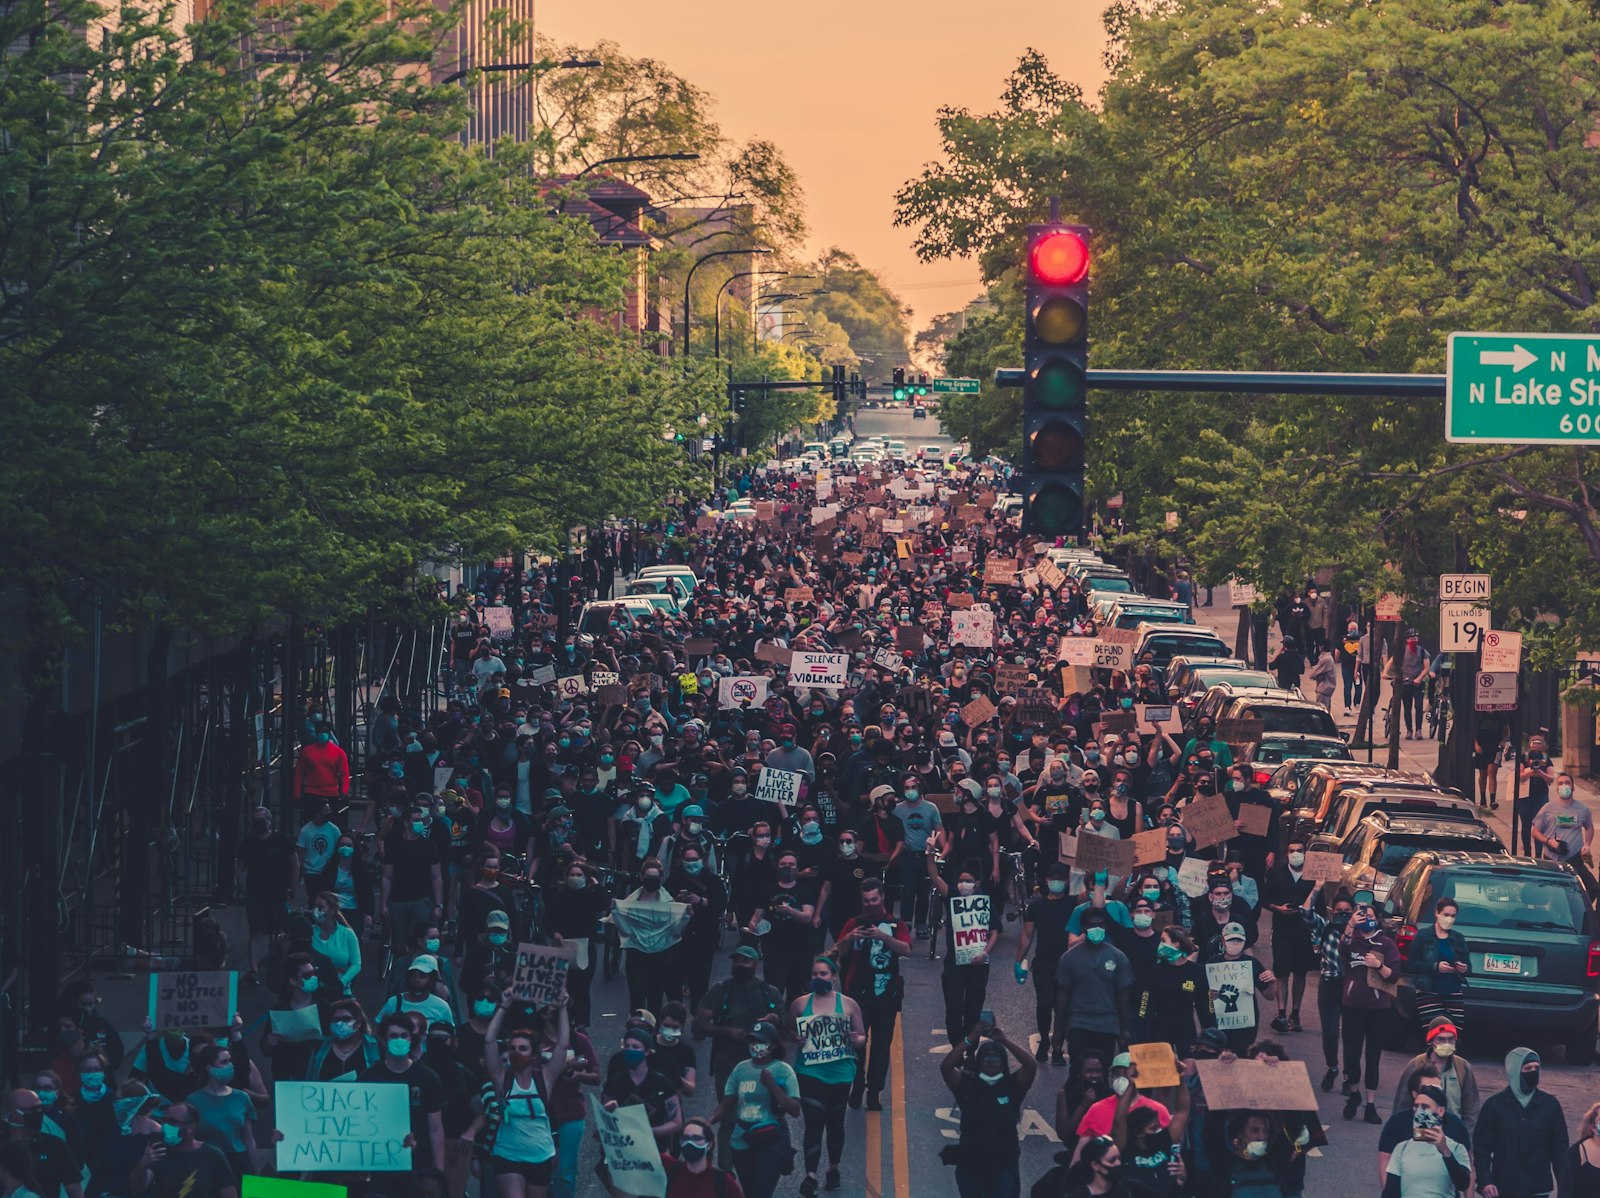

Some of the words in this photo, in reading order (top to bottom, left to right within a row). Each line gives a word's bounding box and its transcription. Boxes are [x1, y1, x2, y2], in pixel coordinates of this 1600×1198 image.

[1551, 351, 1565, 372] N
[1470, 383, 1485, 404] N
[1495, 376, 1562, 405] Lake
[1039, 560, 1064, 587] BLM
[1445, 580, 1486, 594] BEGIN
[1453, 622, 1478, 643] 19
[1095, 645, 1124, 656] DEFUND
[804, 655, 843, 665] SILENCE
[876, 650, 902, 670] BLM
[1097, 655, 1120, 666] CPD
[794, 672, 842, 684] VIOLENCE
[766, 769, 794, 781] BLACK
[765, 780, 793, 791] LIVES
[756, 786, 794, 802] MATTER
[1307, 869, 1339, 877] MATTER
[953, 898, 990, 914] BLACK
[519, 952, 569, 972] BLACK
[1209, 962, 1249, 973] BLACK
[176, 974, 198, 991] NO
[516, 967, 566, 988] LIVES
[1215, 972, 1246, 982] LIVES
[162, 986, 224, 1000] JUSTICE
[512, 983, 561, 1003] MATTER
[177, 1001, 198, 1012] NO
[164, 1014, 208, 1027] PEACE
[799, 1020, 823, 1038] END
[301, 1085, 378, 1113] BLACK
[304, 1115, 379, 1137] LIVES
[293, 1139, 402, 1168] MATTER
